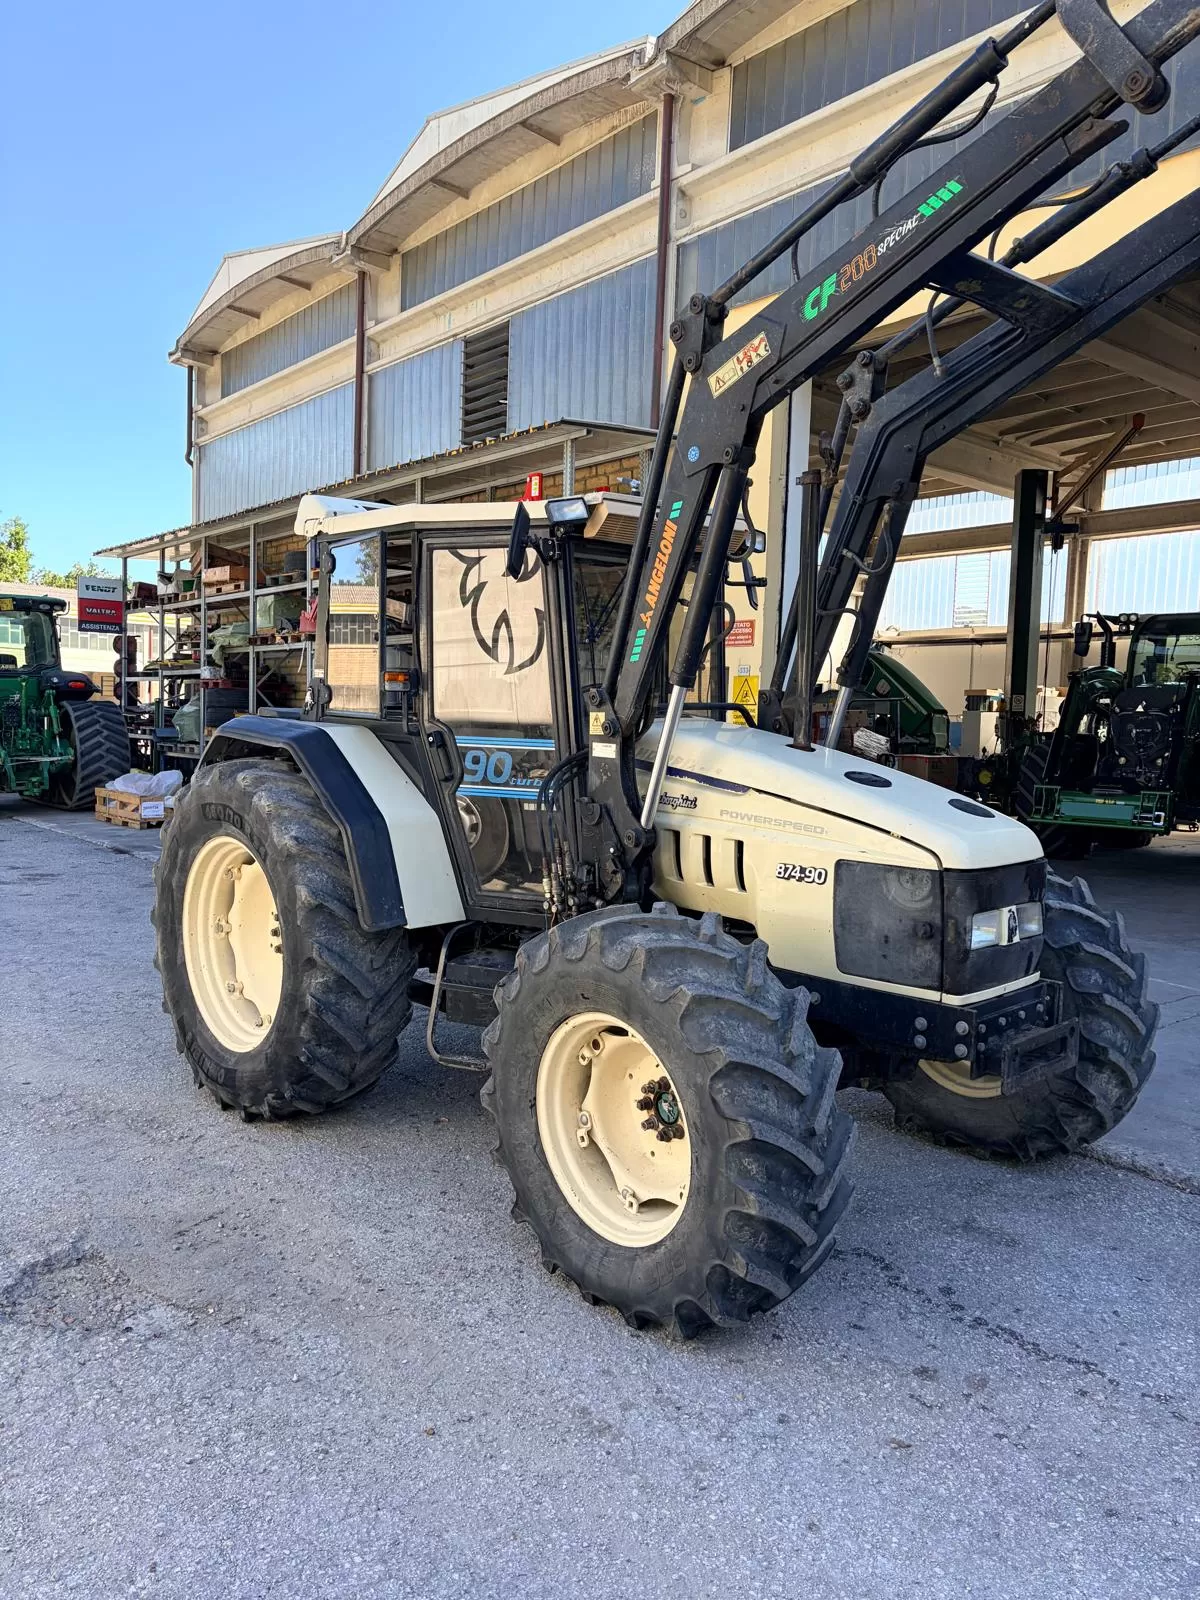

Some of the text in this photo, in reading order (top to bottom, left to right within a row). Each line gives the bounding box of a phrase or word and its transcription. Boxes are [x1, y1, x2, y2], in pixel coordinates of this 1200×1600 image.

[801, 214, 920, 321] CF 200 SPECIAL
[643, 518, 679, 609] ANGELONI
[85, 584, 118, 593] FENDT
[85, 607, 117, 616] VALTRA
[81, 623, 120, 631] ASSISTENZA
[463, 749, 544, 787] 90 turb
[719, 808, 825, 835] POWERSPEED
[775, 862, 828, 886] 874-90
